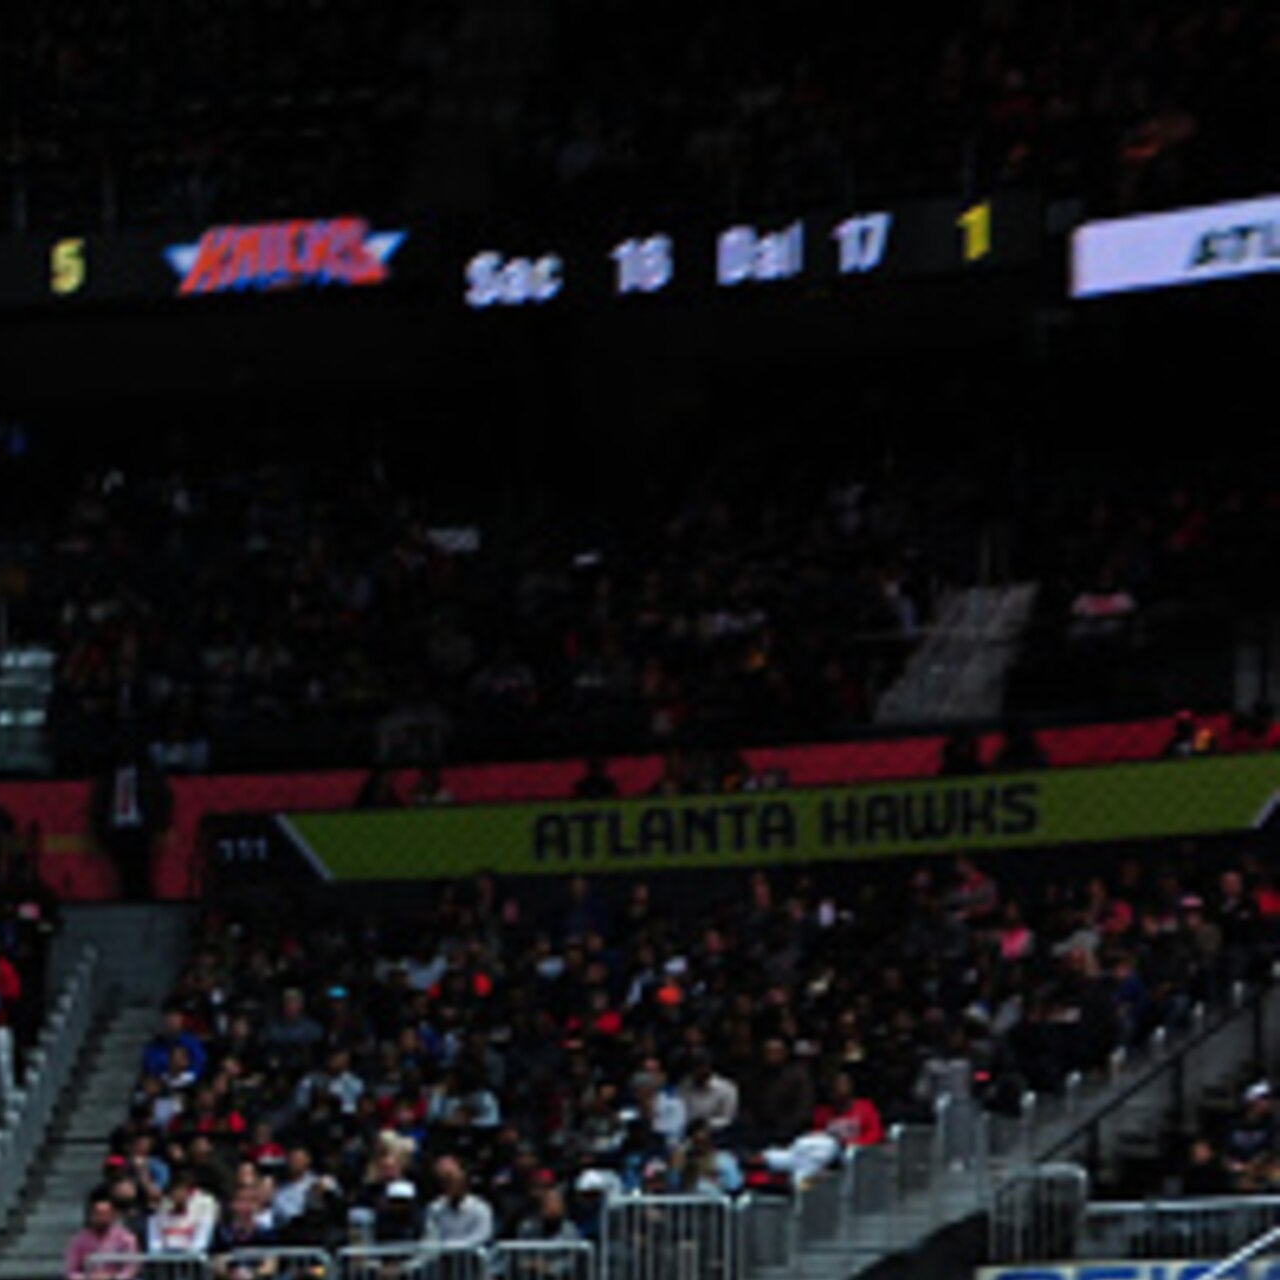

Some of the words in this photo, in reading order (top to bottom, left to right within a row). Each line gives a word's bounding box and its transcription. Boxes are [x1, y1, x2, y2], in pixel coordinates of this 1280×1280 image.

[52, 238, 85, 294] 5
[832, 211, 893, 273] 17
[959, 203, 989, 260] 1
[534, 799, 796, 860] ATLANTA
[821, 784, 1038, 842] HAWKS
